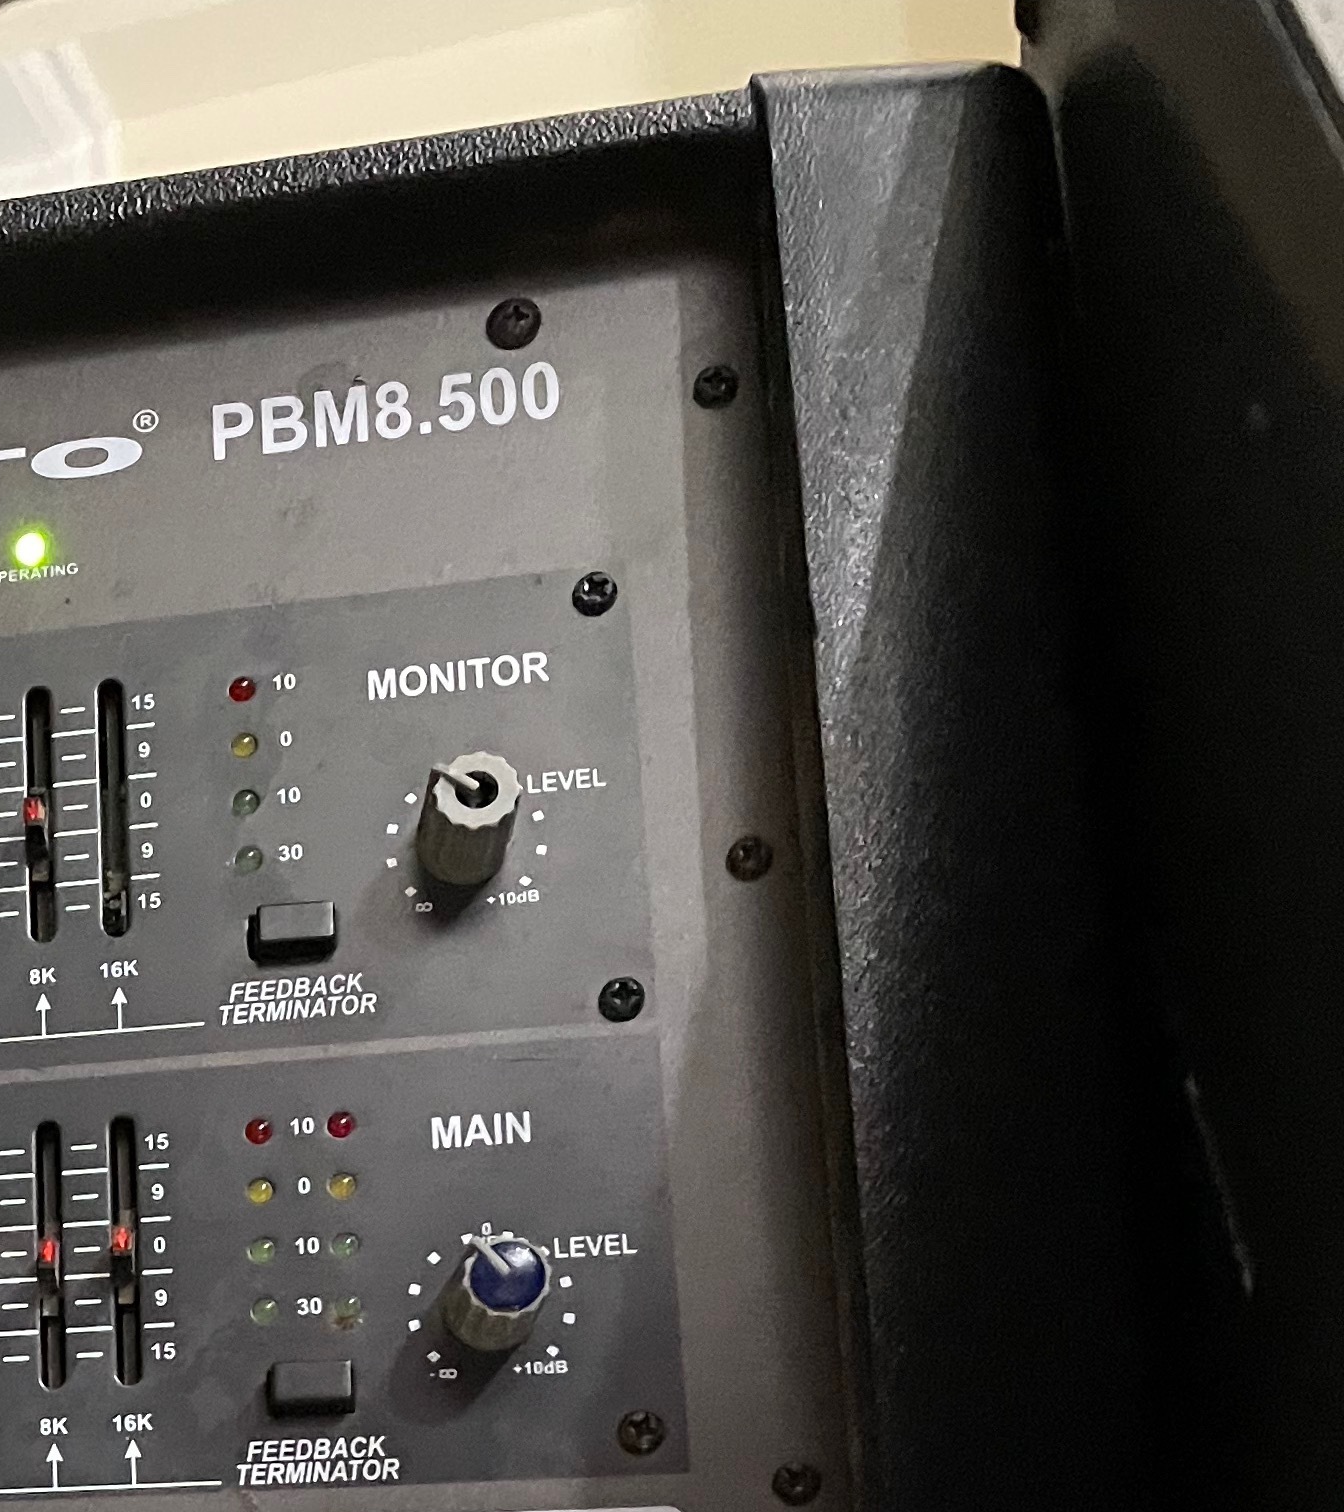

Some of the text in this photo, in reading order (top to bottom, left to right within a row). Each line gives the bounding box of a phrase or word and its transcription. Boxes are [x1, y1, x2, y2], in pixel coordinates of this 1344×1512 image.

[213, 362, 559, 460] PBM8.500
[273, 674, 296, 690] 10
[368, 652, 549, 700] MONITOR
[281, 731, 292, 746] 0
[527, 768, 606, 793] LEVEL
[277, 787, 300, 804] 10
[279, 844, 302, 861] 30
[30, 967, 56, 984] 8K
[100, 960, 138, 978] 16K
[229, 973, 363, 1003] FEEDBACK
[219, 993, 377, 1026] TERMINATOR
[290, 1117, 314, 1135] 10
[431, 1111, 531, 1149] MAIN
[298, 1177, 310, 1194] 0
[295, 1237, 319, 1254] 10
[554, 1234, 637, 1258] LEVEL
[297, 1297, 322, 1315] 30
[40, 1418, 68, 1435] 8K
[113, 1414, 153, 1431] 16K
[246, 1436, 386, 1463] FEEDBACK
[237, 1459, 399, 1485] TERMINATOR
